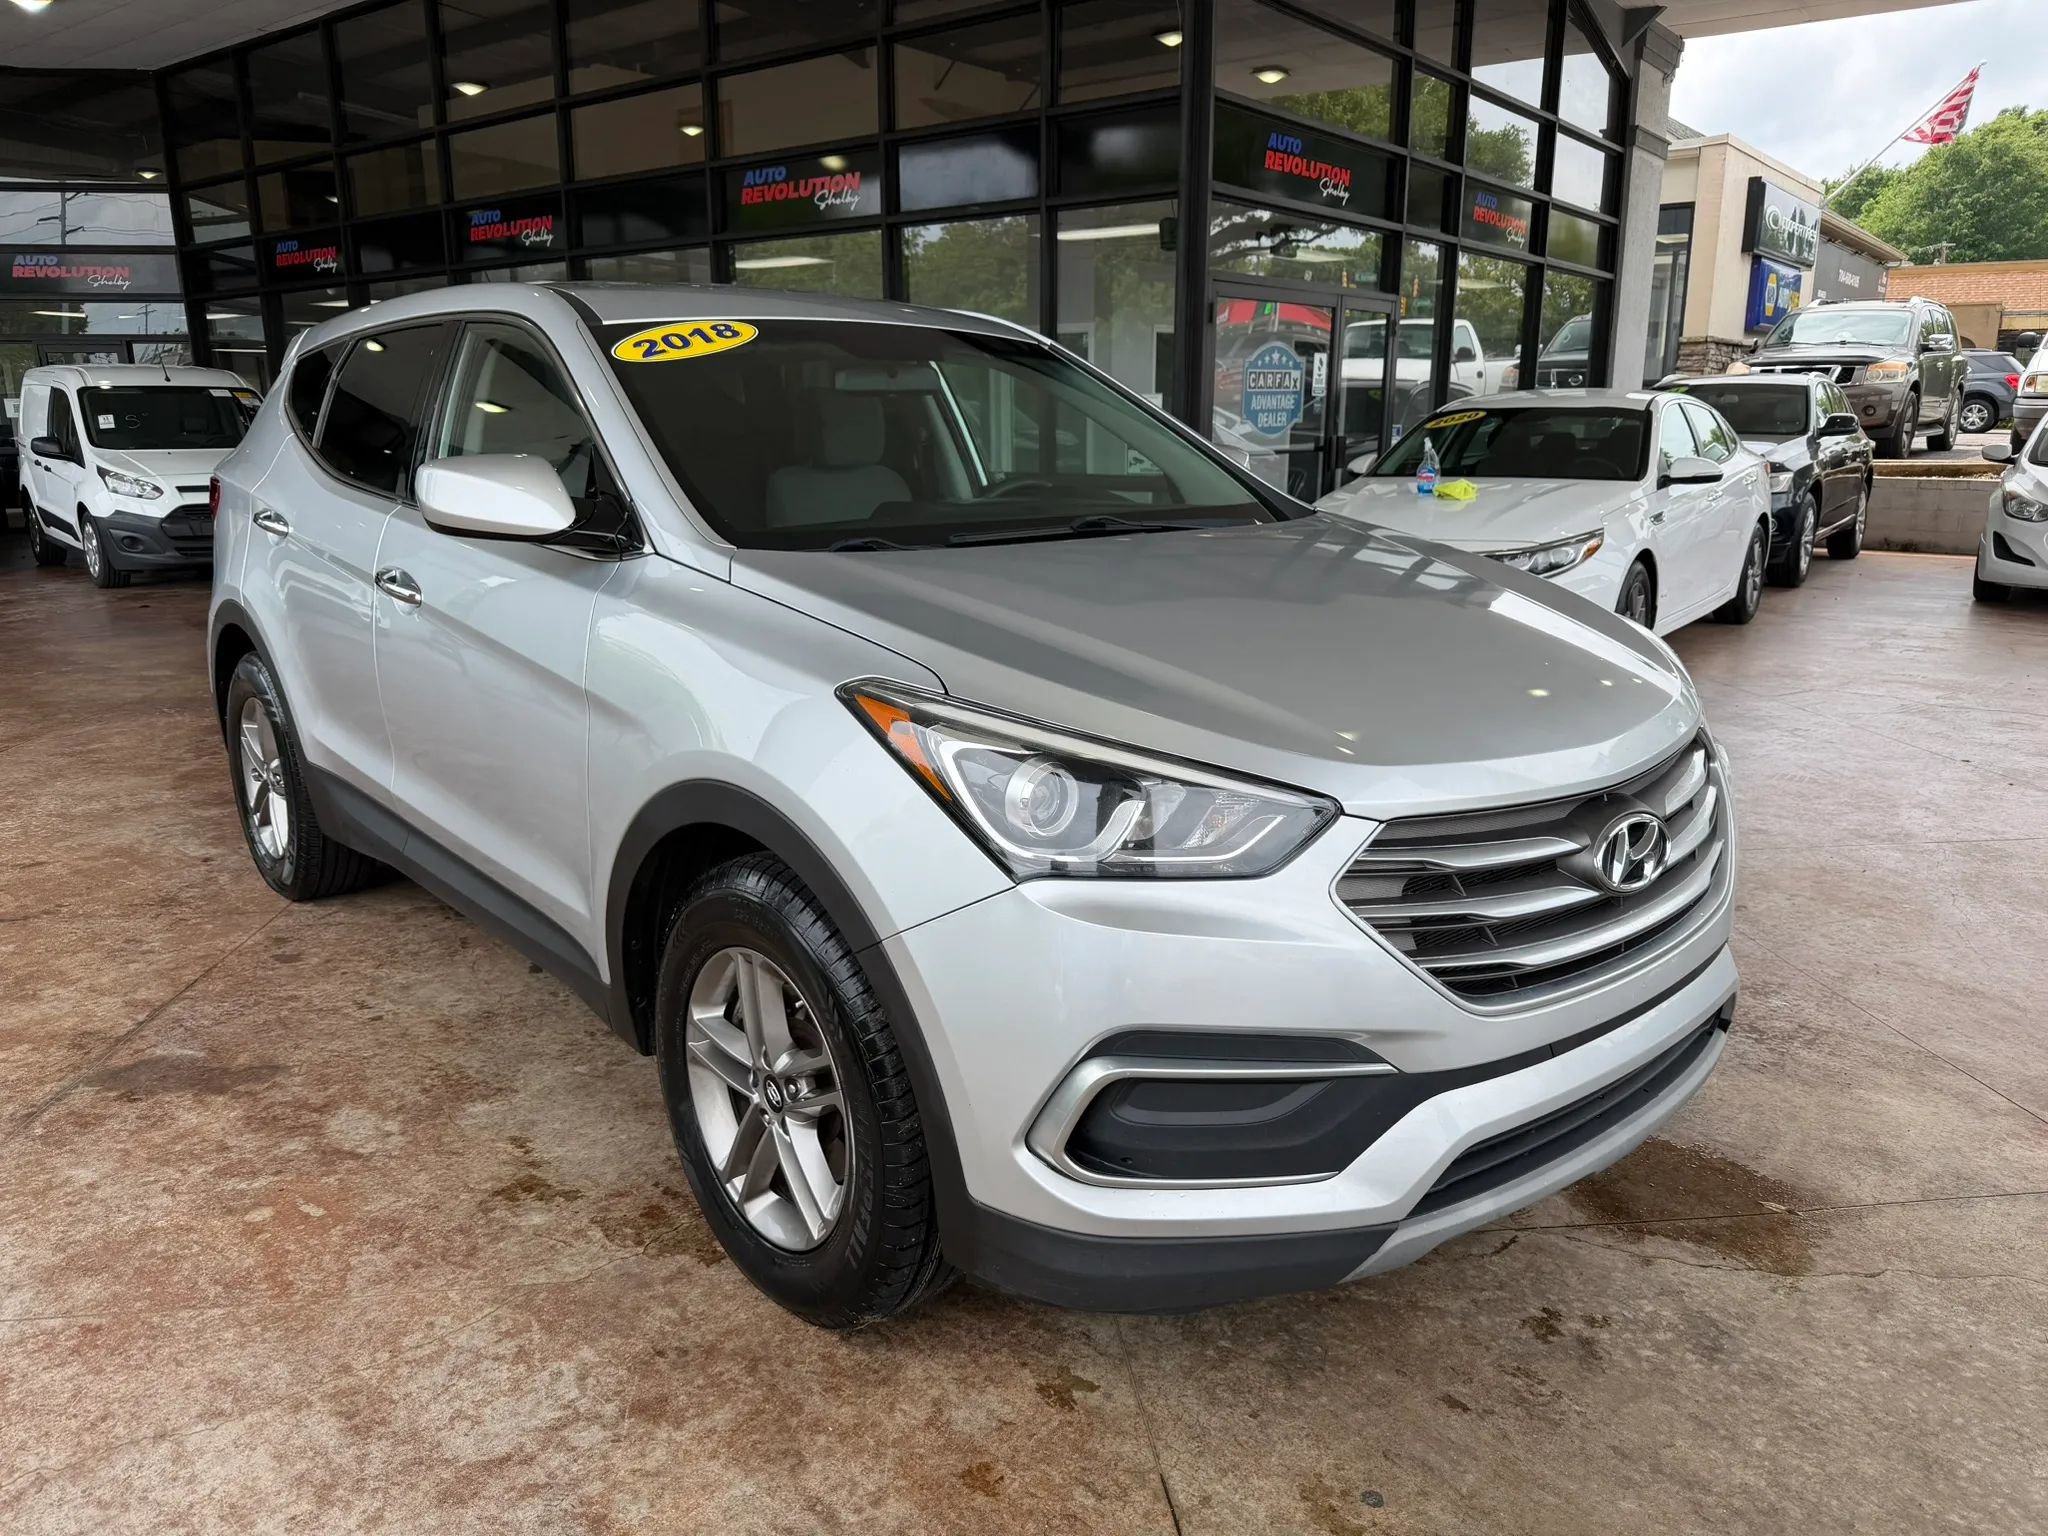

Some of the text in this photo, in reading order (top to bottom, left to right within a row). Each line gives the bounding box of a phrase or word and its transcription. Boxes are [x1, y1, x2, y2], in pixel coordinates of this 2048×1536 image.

[1268, 132, 1302, 155] AUTO
[744, 166, 786, 186] AUTO
[1264, 150, 1351, 187] REVOLUTION
[741, 172, 861, 205] REVOLUTION
[814, 186, 861, 211] Shelby
[1319, 177, 1351, 207] Shelby
[1475, 192, 1498, 209] AUTO
[472, 209, 501, 226] AUTO
[1472, 206, 1528, 237] REVOLUTION
[470, 215, 553, 241] REVOLUTION
[521, 226, 554, 247] Shelby
[275, 246, 337, 267] REVOLUTION
[276, 240, 299, 253] AUTO
[14, 255, 58, 266] AUTO
[12, 265, 129, 278] REVOLUTION
[87, 274, 132, 290] Shelby
[633, 323, 743, 359] 2018
[1248, 371, 1300, 390] CARFAX
[1250, 394, 1296, 410] ADVANTAGE
[1257, 411, 1288, 427] DEALER
